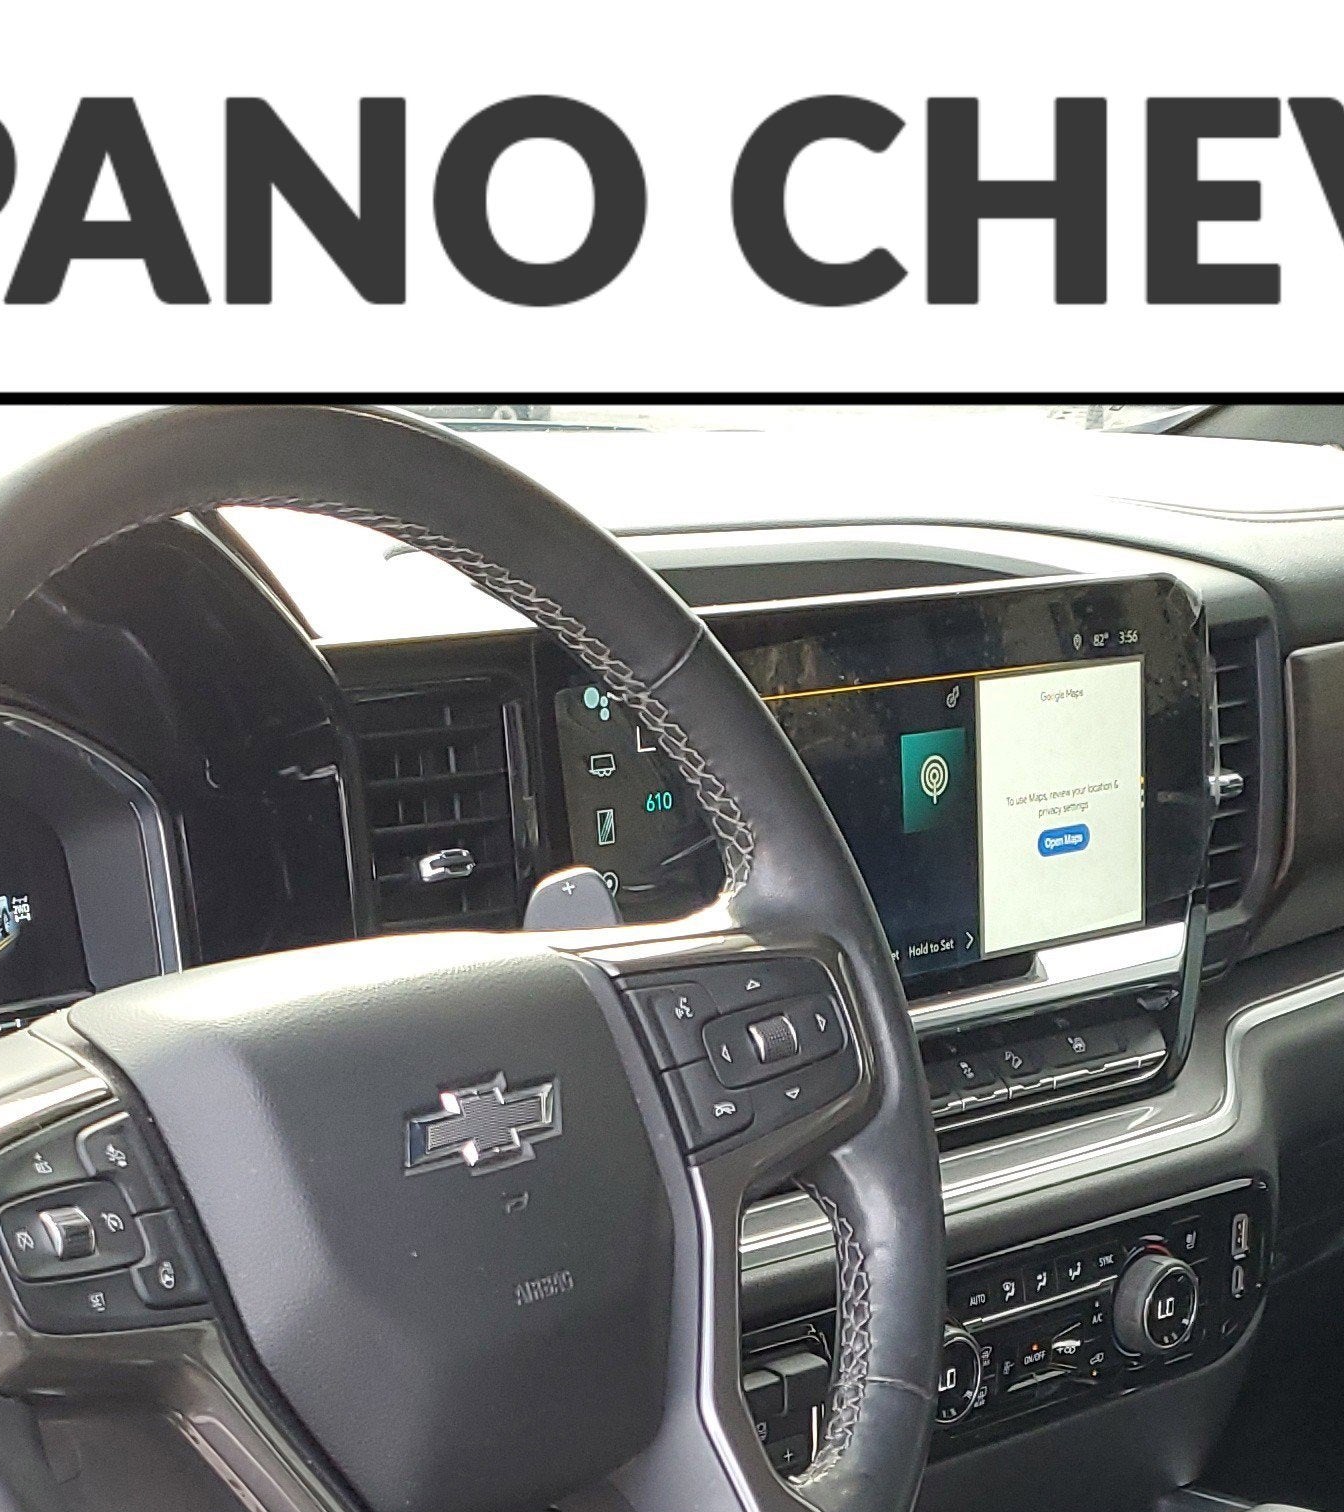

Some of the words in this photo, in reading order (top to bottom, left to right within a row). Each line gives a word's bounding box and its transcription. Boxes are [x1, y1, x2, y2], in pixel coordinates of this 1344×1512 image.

[1040, 691, 1065, 703] Google
[1065, 688, 1084, 700] Maps
[645, 791, 673, 812] 610
[1006, 796, 1014, 806] To
[1016, 796, 1027, 806] use
[1049, 790, 1071, 800] review
[1071, 786, 1087, 798] your
[1087, 782, 1112, 794] location
[1038, 806, 1062, 819] privacy
[1063, 801, 1089, 813] settings
[1044, 835, 1063, 850] Open
[1064, 833, 1084, 847] Maps
[908, 941, 929, 959] Hold
[930, 943, 940, 953] to
[940, 938, 955, 952] Set
[1098, 1253, 1114, 1268] SYNC
[969, 1293, 986, 1307] AUTO
[1157, 1296, 1175, 1320] LO
[1091, 1312, 1103, 1325] A/C
[1023, 1350, 1046, 1366] ON/OFF
